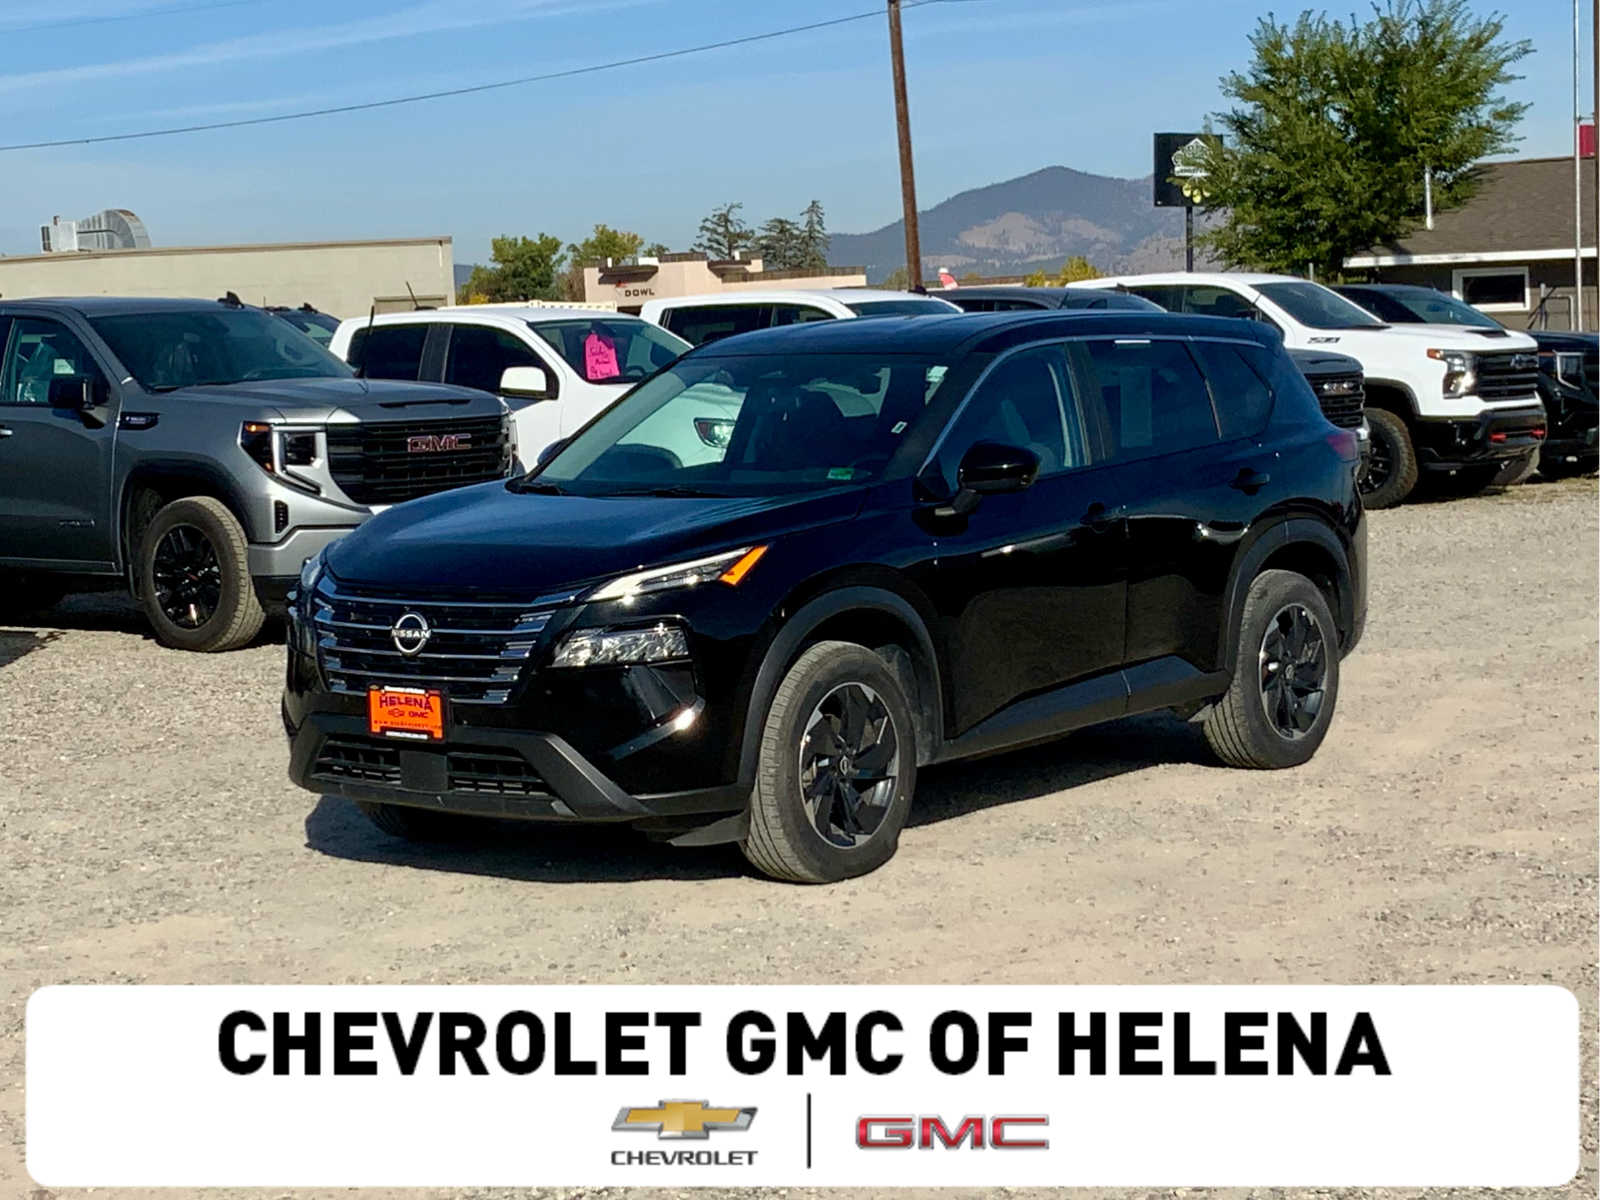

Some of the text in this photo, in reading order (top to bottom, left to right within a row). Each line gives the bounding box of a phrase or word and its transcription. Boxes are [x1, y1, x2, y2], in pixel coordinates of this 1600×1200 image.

[624, 287, 656, 297] DOWL
[407, 433, 472, 453] GMC
[391, 628, 432, 639] NISSAN
[379, 695, 434, 713] HELENA
